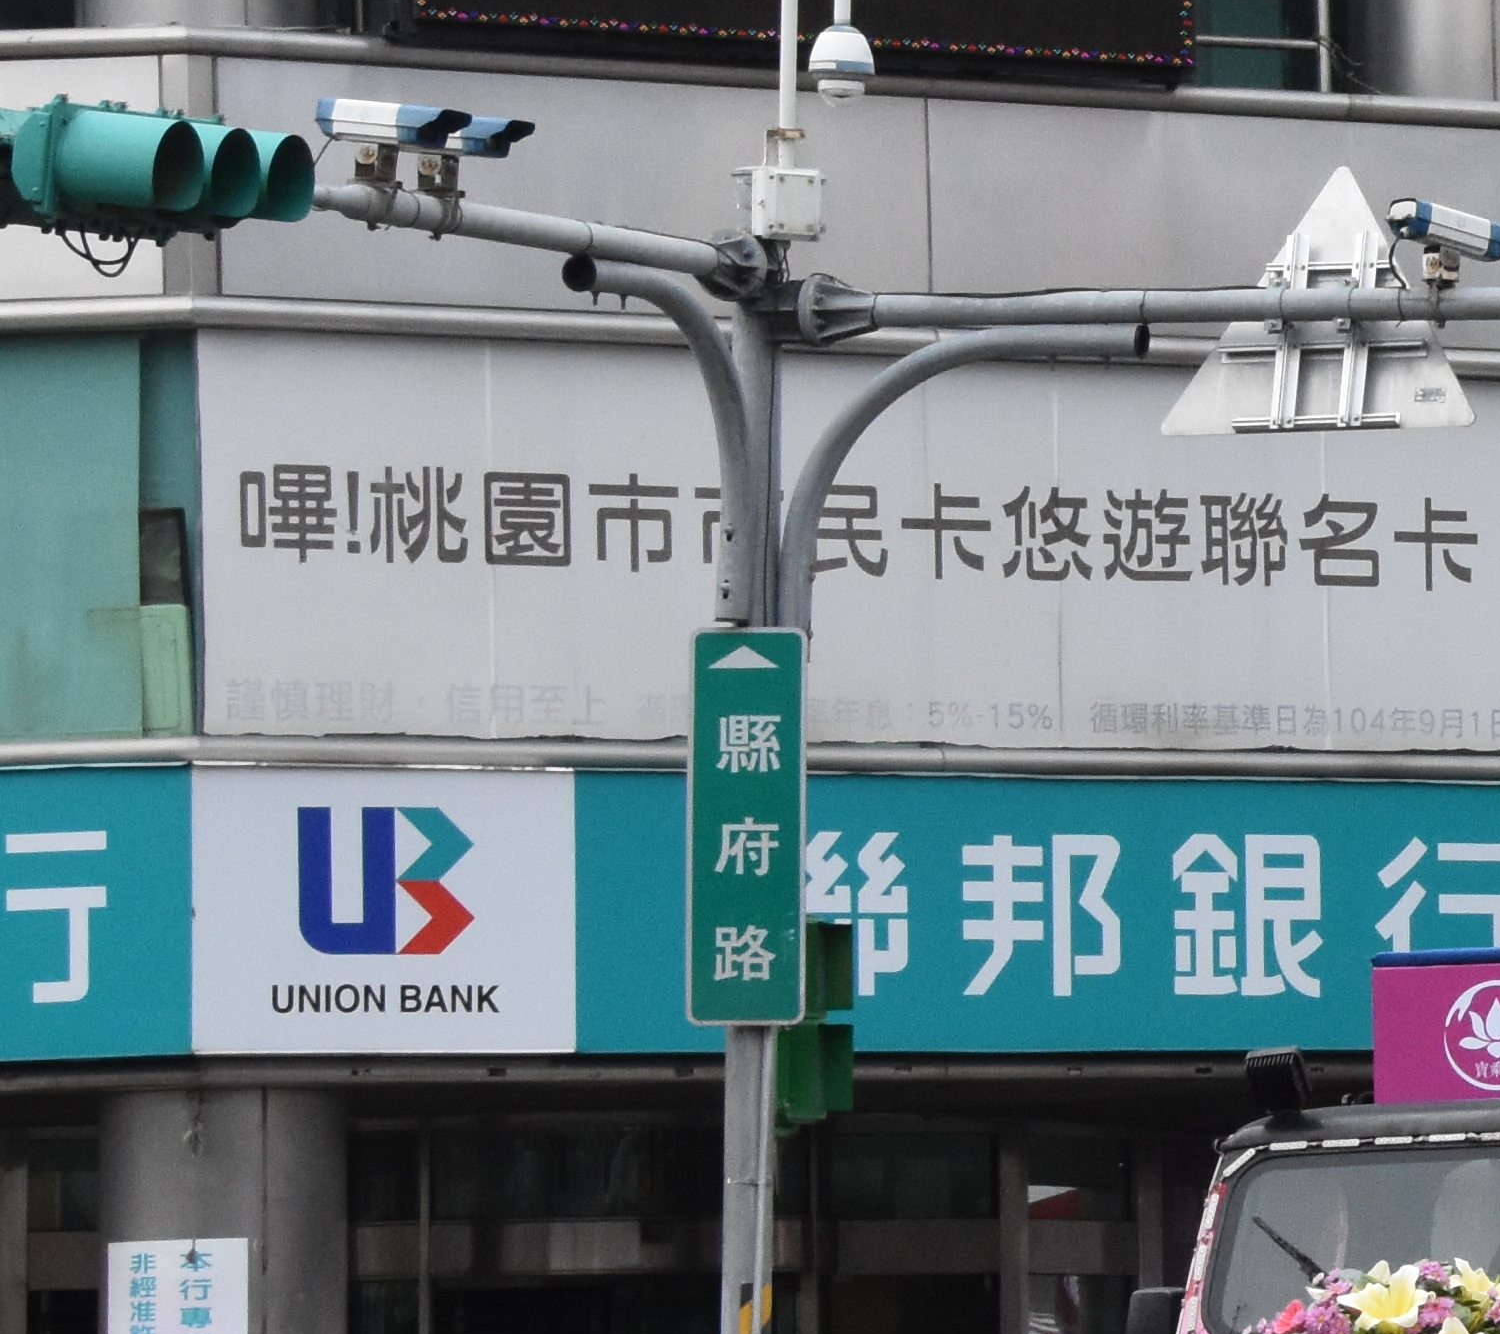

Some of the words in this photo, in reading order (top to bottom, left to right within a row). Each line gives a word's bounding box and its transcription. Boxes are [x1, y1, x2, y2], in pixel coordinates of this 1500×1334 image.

[713, 714, 782, 984] 縣府路
[271, 982, 387, 1015] UNION
[400, 982, 500, 1015] BANK
